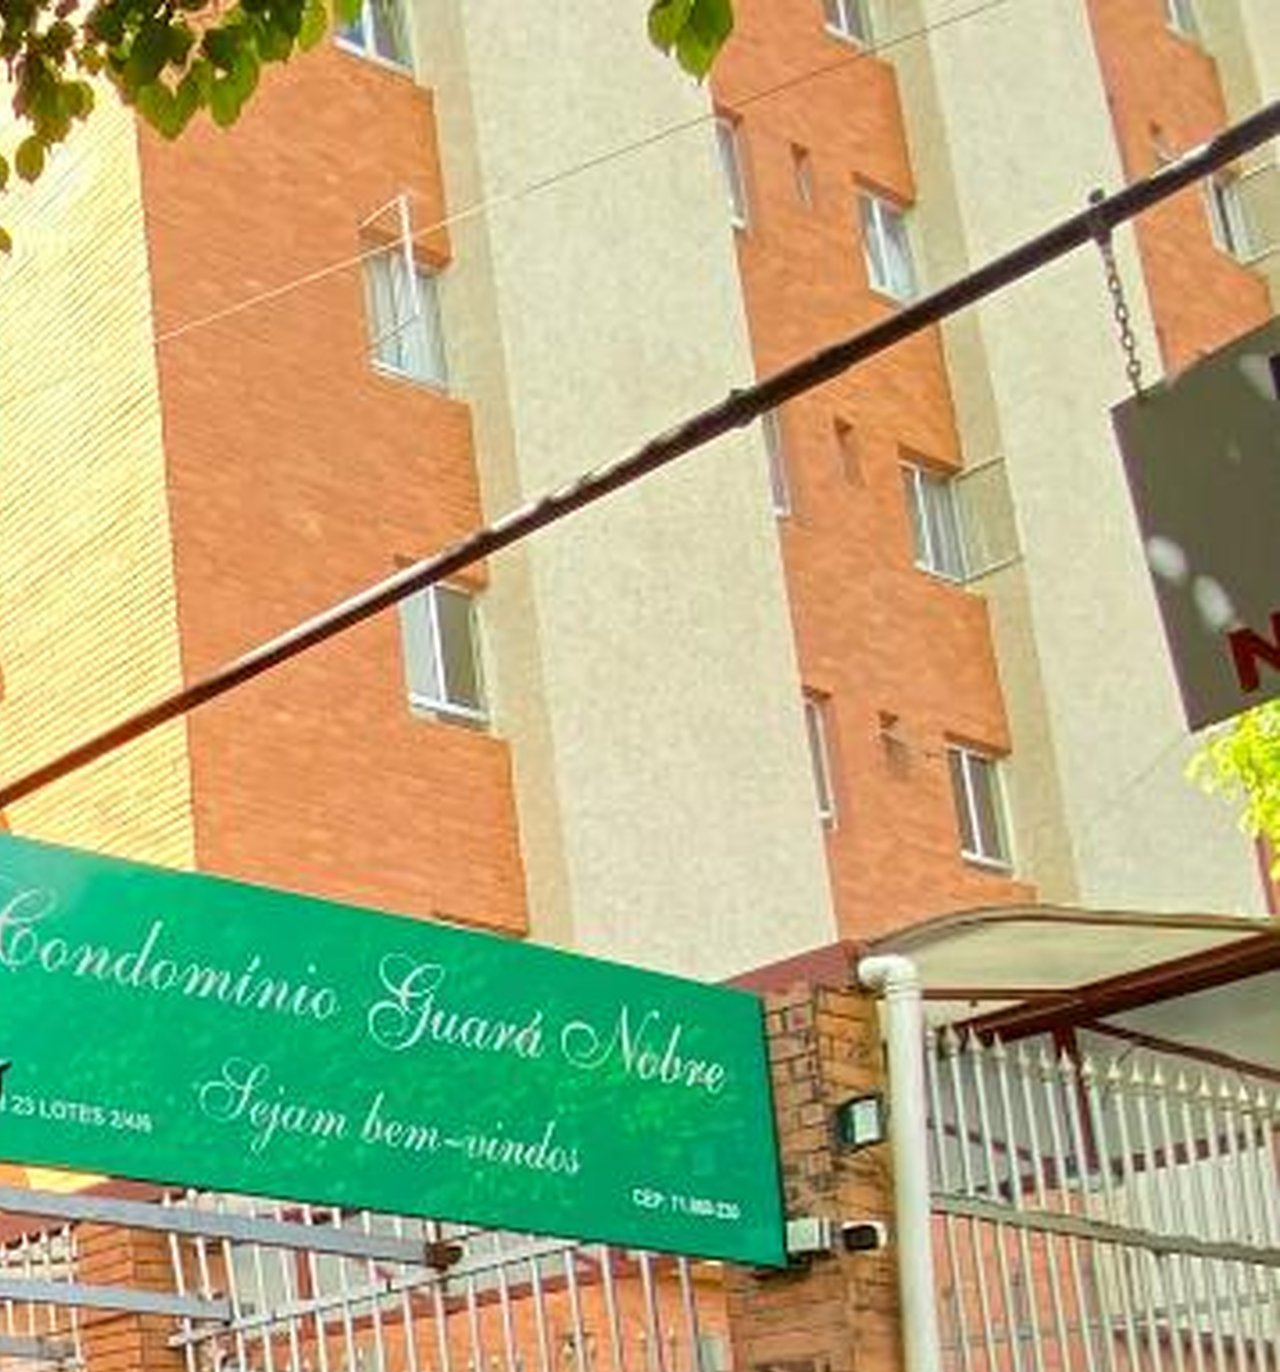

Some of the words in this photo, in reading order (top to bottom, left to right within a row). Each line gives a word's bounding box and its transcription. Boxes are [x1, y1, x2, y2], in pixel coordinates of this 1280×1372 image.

[368, 952, 545, 1057] Guará
[560, 1004, 725, 1094] Nobre
[11, 1095, 36, 1116] 23
[40, 1100, 106, 1126] LOTES
[198, 1056, 348, 1156] Sejam
[359, 1091, 582, 1175] bem-vindos
